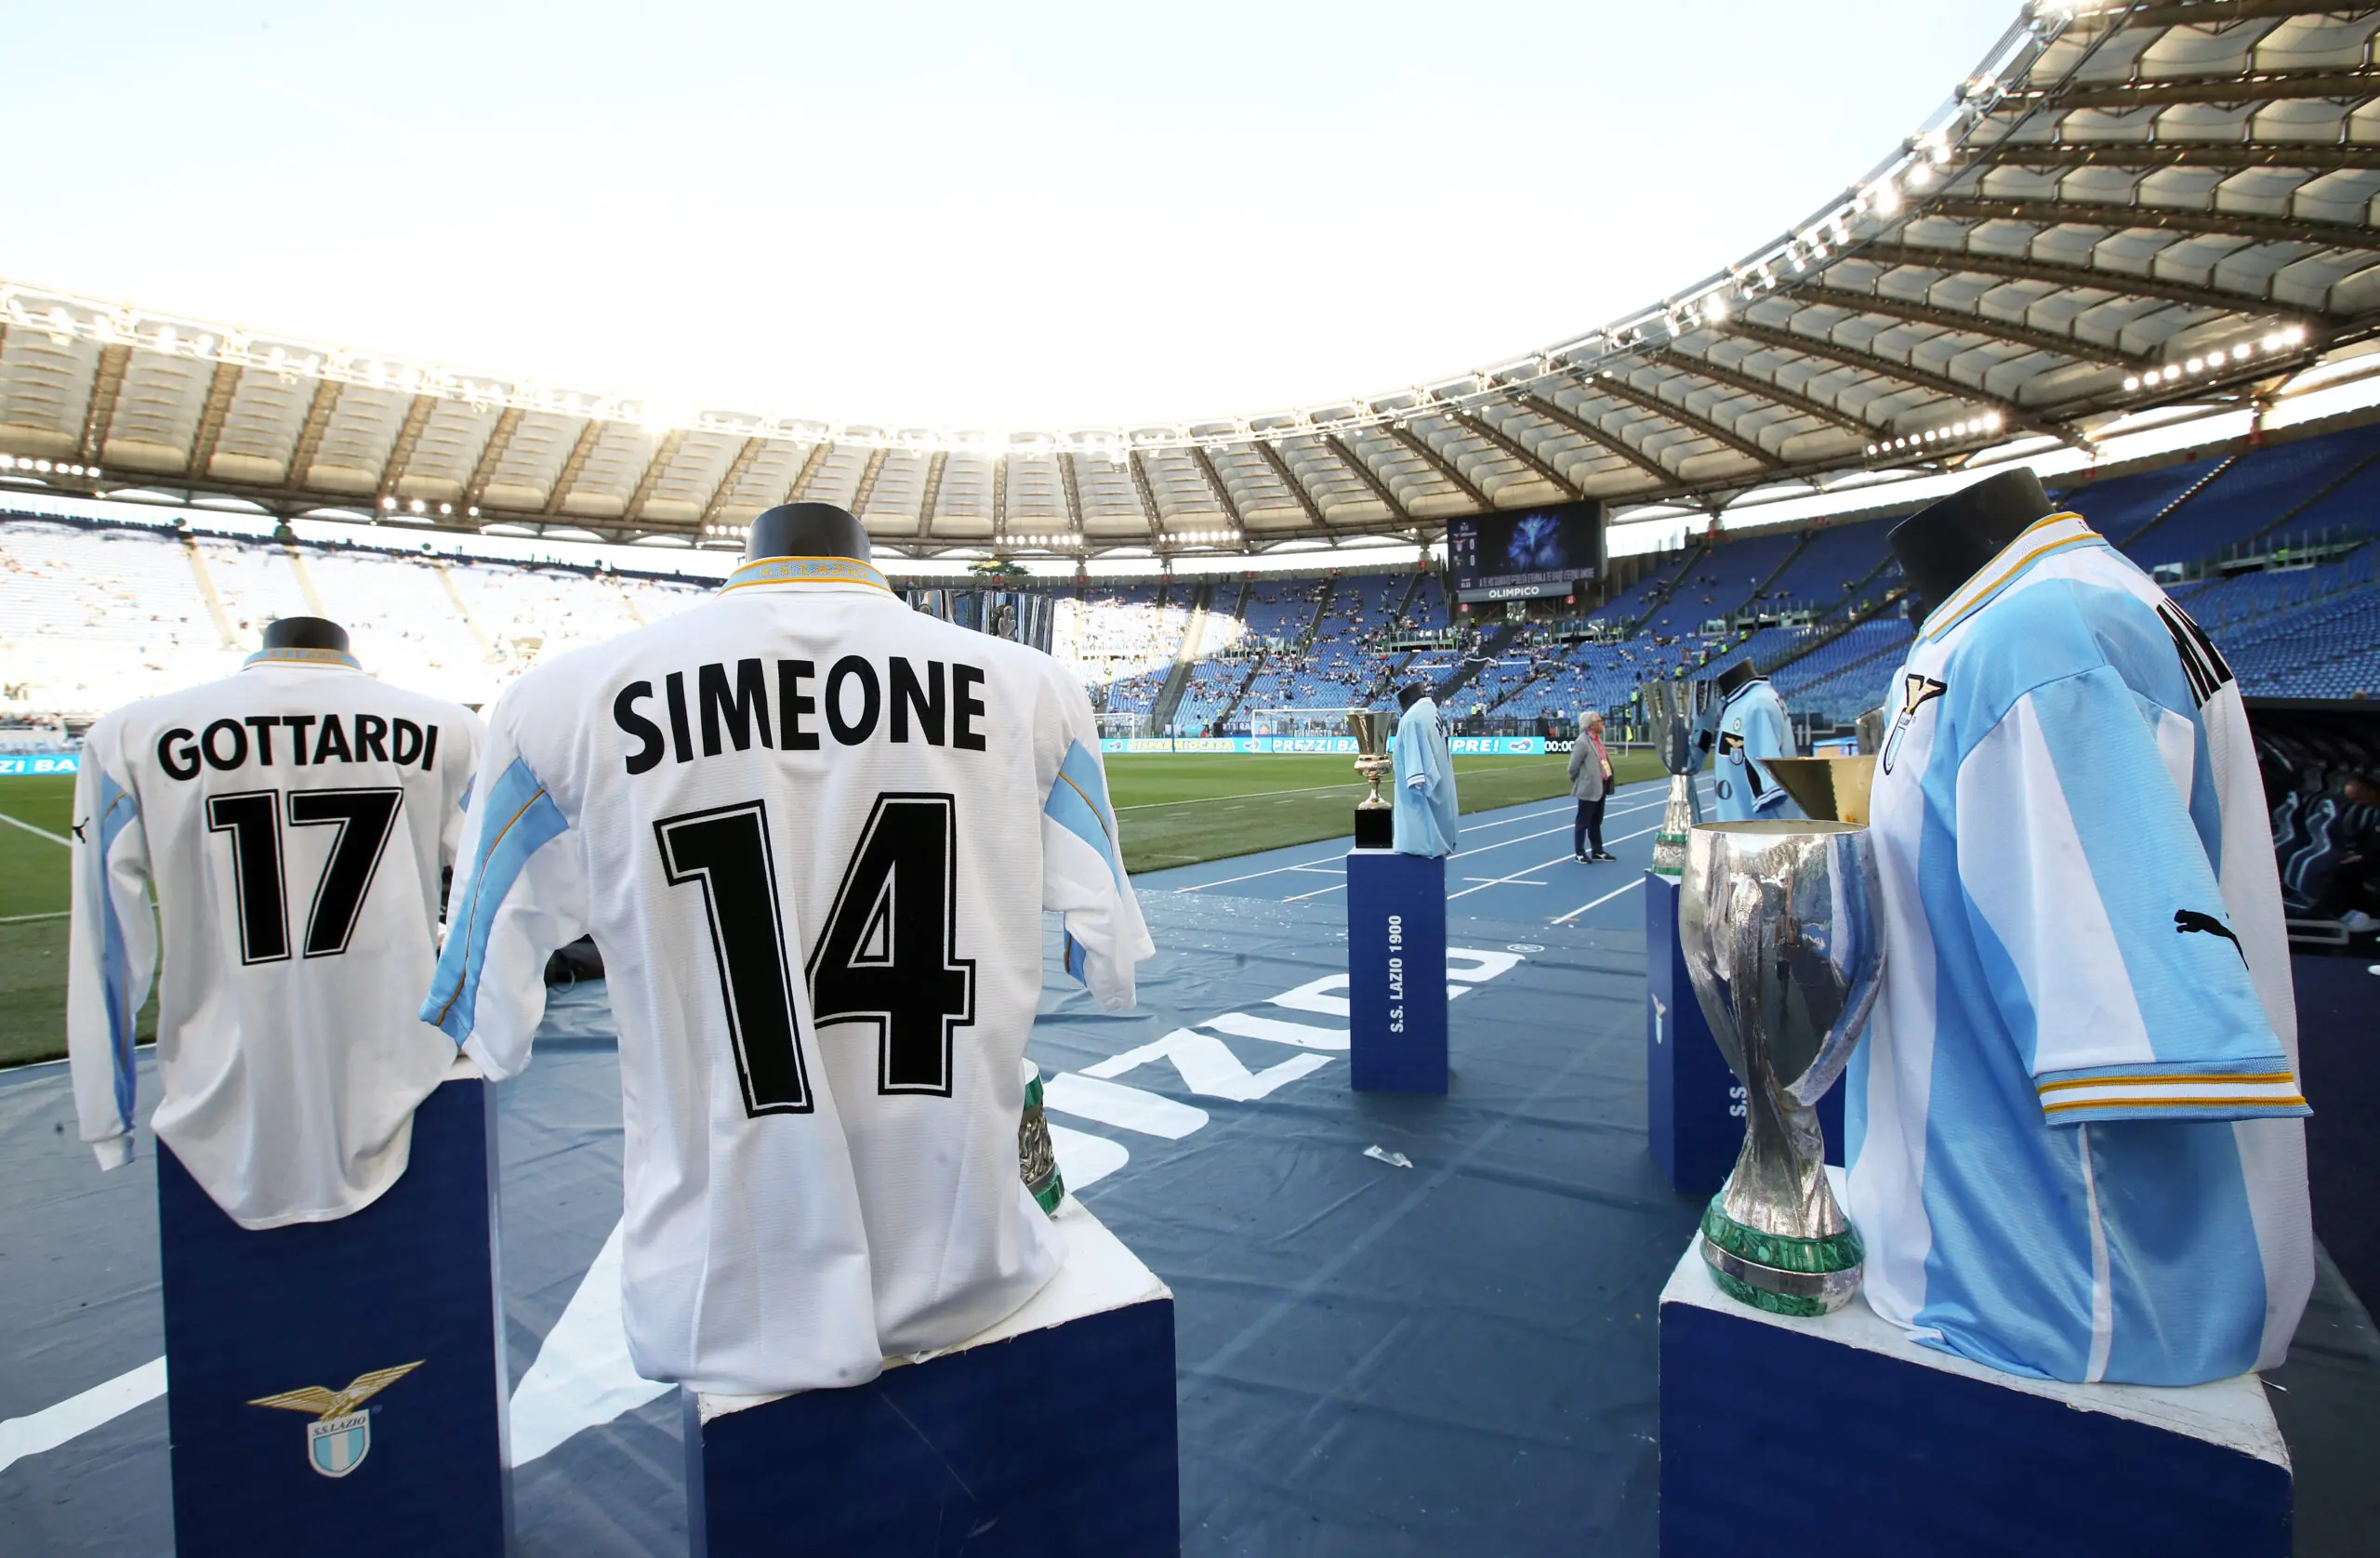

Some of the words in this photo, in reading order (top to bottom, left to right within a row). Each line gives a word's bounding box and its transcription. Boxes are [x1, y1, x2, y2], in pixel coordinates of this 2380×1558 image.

[1489, 587, 1540, 599] OLIMPICO
[613, 655, 985, 775] SIMEONE
[156, 713, 439, 781] GOTTARDI
[1273, 739, 1333, 752] PREZZI
[1448, 739, 1500, 752] PRE!
[205, 786, 403, 966] 17
[652, 792, 976, 1119] 14
[1388, 915, 1402, 953] 1900
[1389, 957, 1403, 1000] LAZIO
[1390, 1005, 1404, 1033] S.S.
